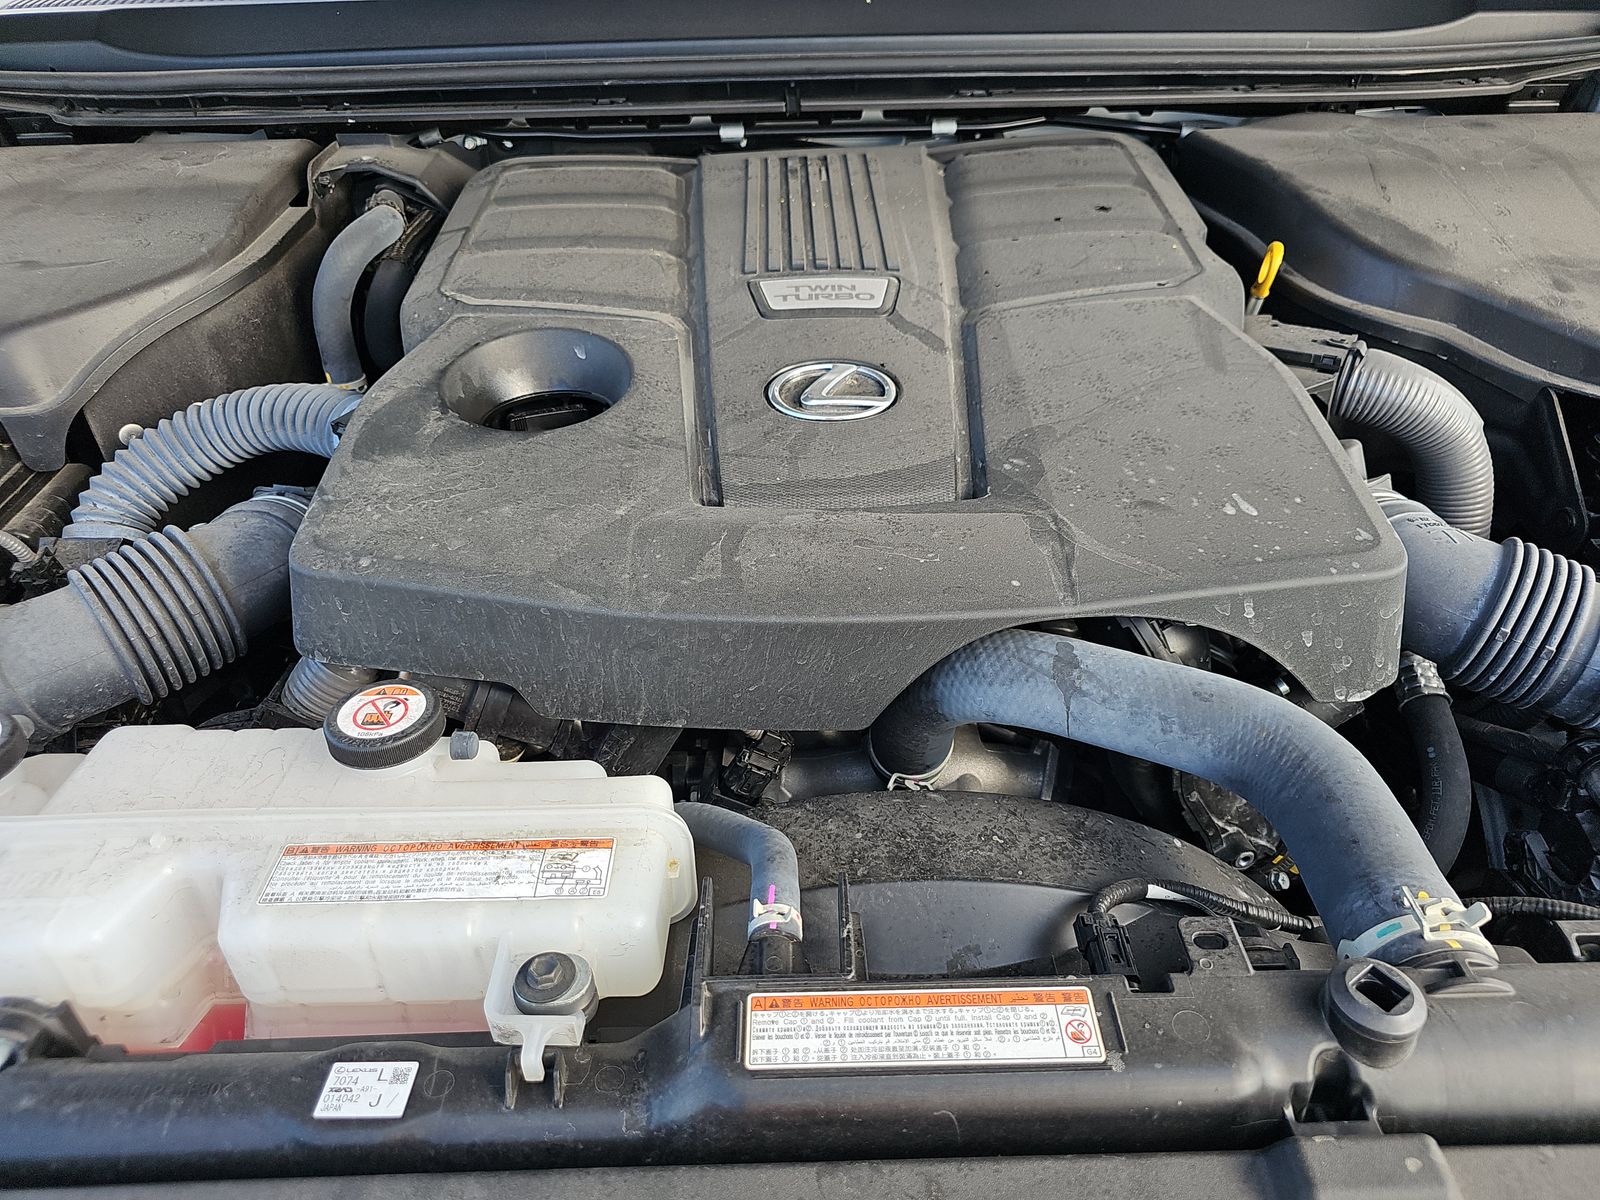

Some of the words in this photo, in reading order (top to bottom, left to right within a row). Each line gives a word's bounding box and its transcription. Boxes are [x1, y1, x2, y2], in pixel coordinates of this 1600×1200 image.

[786, 284, 856, 292] TWIN
[774, 293, 875, 302] TURBO
[753, 998, 762, 1008] A
[809, 996, 853, 1007] WARNING
[859, 995, 921, 1006] ОСТОРОЖНО
[926, 993, 1003, 1005] AVERTISSEMENT
[995, 1013, 1010, 1021] Cap
[377, 1067, 388, 1082] L
[333, 1075, 360, 1086] 7074
[323, 1093, 361, 1103] 014042
[368, 1093, 383, 1108] J
[320, 1103, 343, 1112] JAPAN
